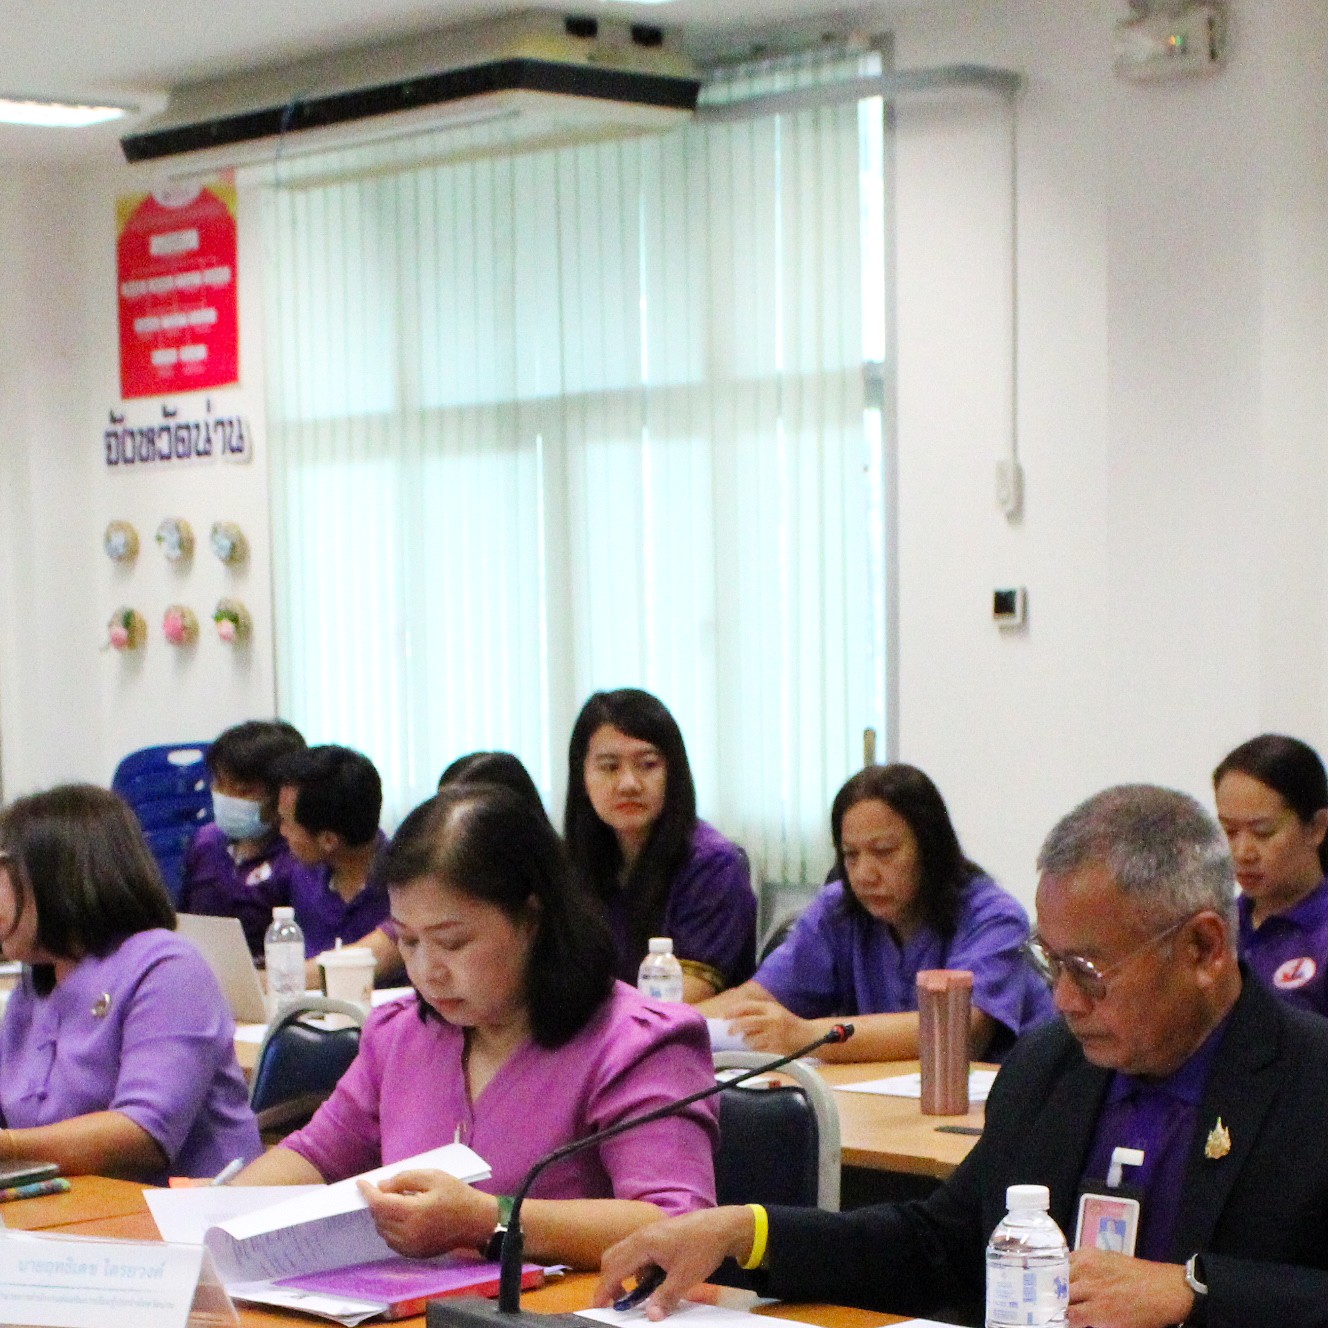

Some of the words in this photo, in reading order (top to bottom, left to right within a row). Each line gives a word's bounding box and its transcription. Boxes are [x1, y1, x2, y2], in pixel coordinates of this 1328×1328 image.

[104, 398, 246, 466] จังหวัดน่าน
